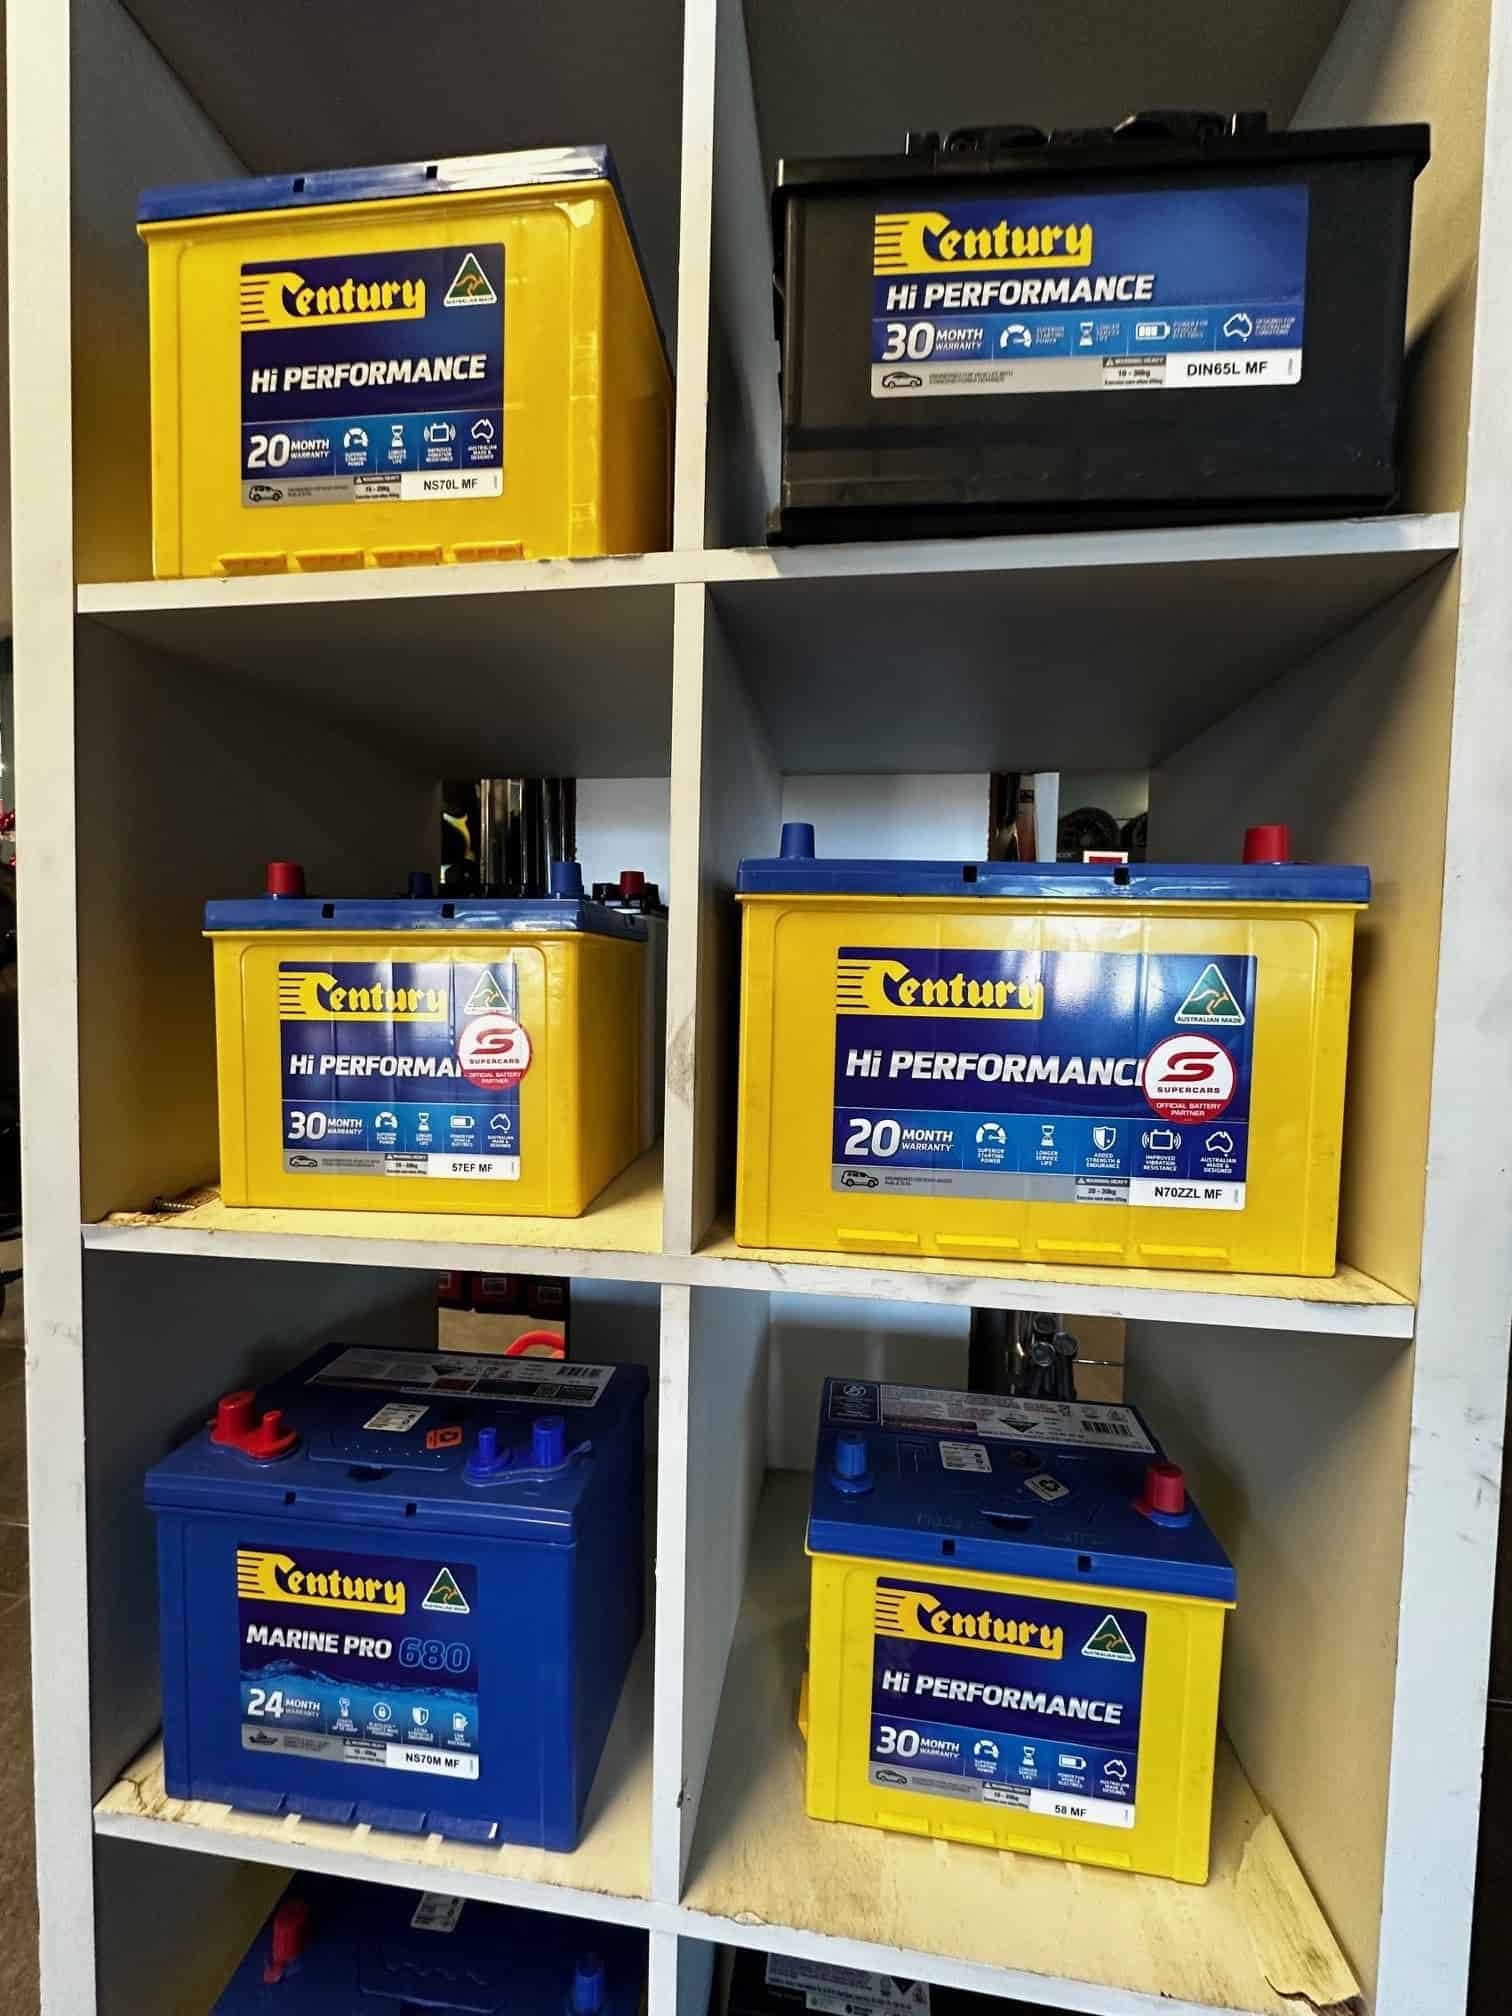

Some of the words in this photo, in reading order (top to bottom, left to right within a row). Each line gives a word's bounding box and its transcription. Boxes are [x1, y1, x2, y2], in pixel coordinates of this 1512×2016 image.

[874, 211, 1093, 276] Century
[241, 272, 425, 332] Century
[886, 283, 918, 310] Hi
[924, 274, 1156, 309] PERFORMANCE
[882, 322, 935, 361] 30
[936, 328, 984, 342] MONTH
[935, 340, 983, 352] WARRANTY
[251, 367, 277, 392] Hi
[284, 354, 487, 391] PERFORMANCE
[1187, 362, 1241, 376] DIN65L
[1245, 361, 1269, 375] MF
[248, 433, 290, 468] 20
[290, 439, 329, 451] MONTH
[423, 480, 459, 491] NS70L
[462, 478, 479, 490] MF
[279, 972, 448, 1021] Century
[836, 959, 1044, 1020] Century
[290, 1054, 313, 1075] Hi
[846, 1049, 880, 1078] Hi
[1157, 1086, 1220, 1094] SUPERCARS
[1189, 1102, 1221, 1110] BATTERY
[288, 1112, 326, 1140] 30
[327, 1118, 362, 1128] MONTH
[845, 1118, 900, 1157] 20
[902, 1128, 953, 1142] MONTH
[452, 1162, 476, 1173] 57EF
[478, 1162, 494, 1174] MF
[1154, 1187, 1200, 1199] N70ZZL
[1204, 1189, 1223, 1200] MF
[237, 1550, 406, 1614] Century
[874, 1587, 1063, 1660] Century
[246, 1624, 339, 1654] MARINE
[344, 1638, 392, 1660] PRO
[398, 1637, 471, 1673] 680
[247, 1688, 284, 1719] 24
[285, 1700, 320, 1711] MONTH
[882, 1669, 910, 1693] Hi
[915, 1676, 1123, 1725] PERFORMANCE
[876, 1726, 920, 1757] 30
[920, 1738, 960, 1751] MONTH
[405, 1752, 441, 1767] NS70M
[444, 1757, 460, 1769] MF
[1055, 1804, 1068, 1815] 58
[1071, 1807, 1087, 1818] MF
